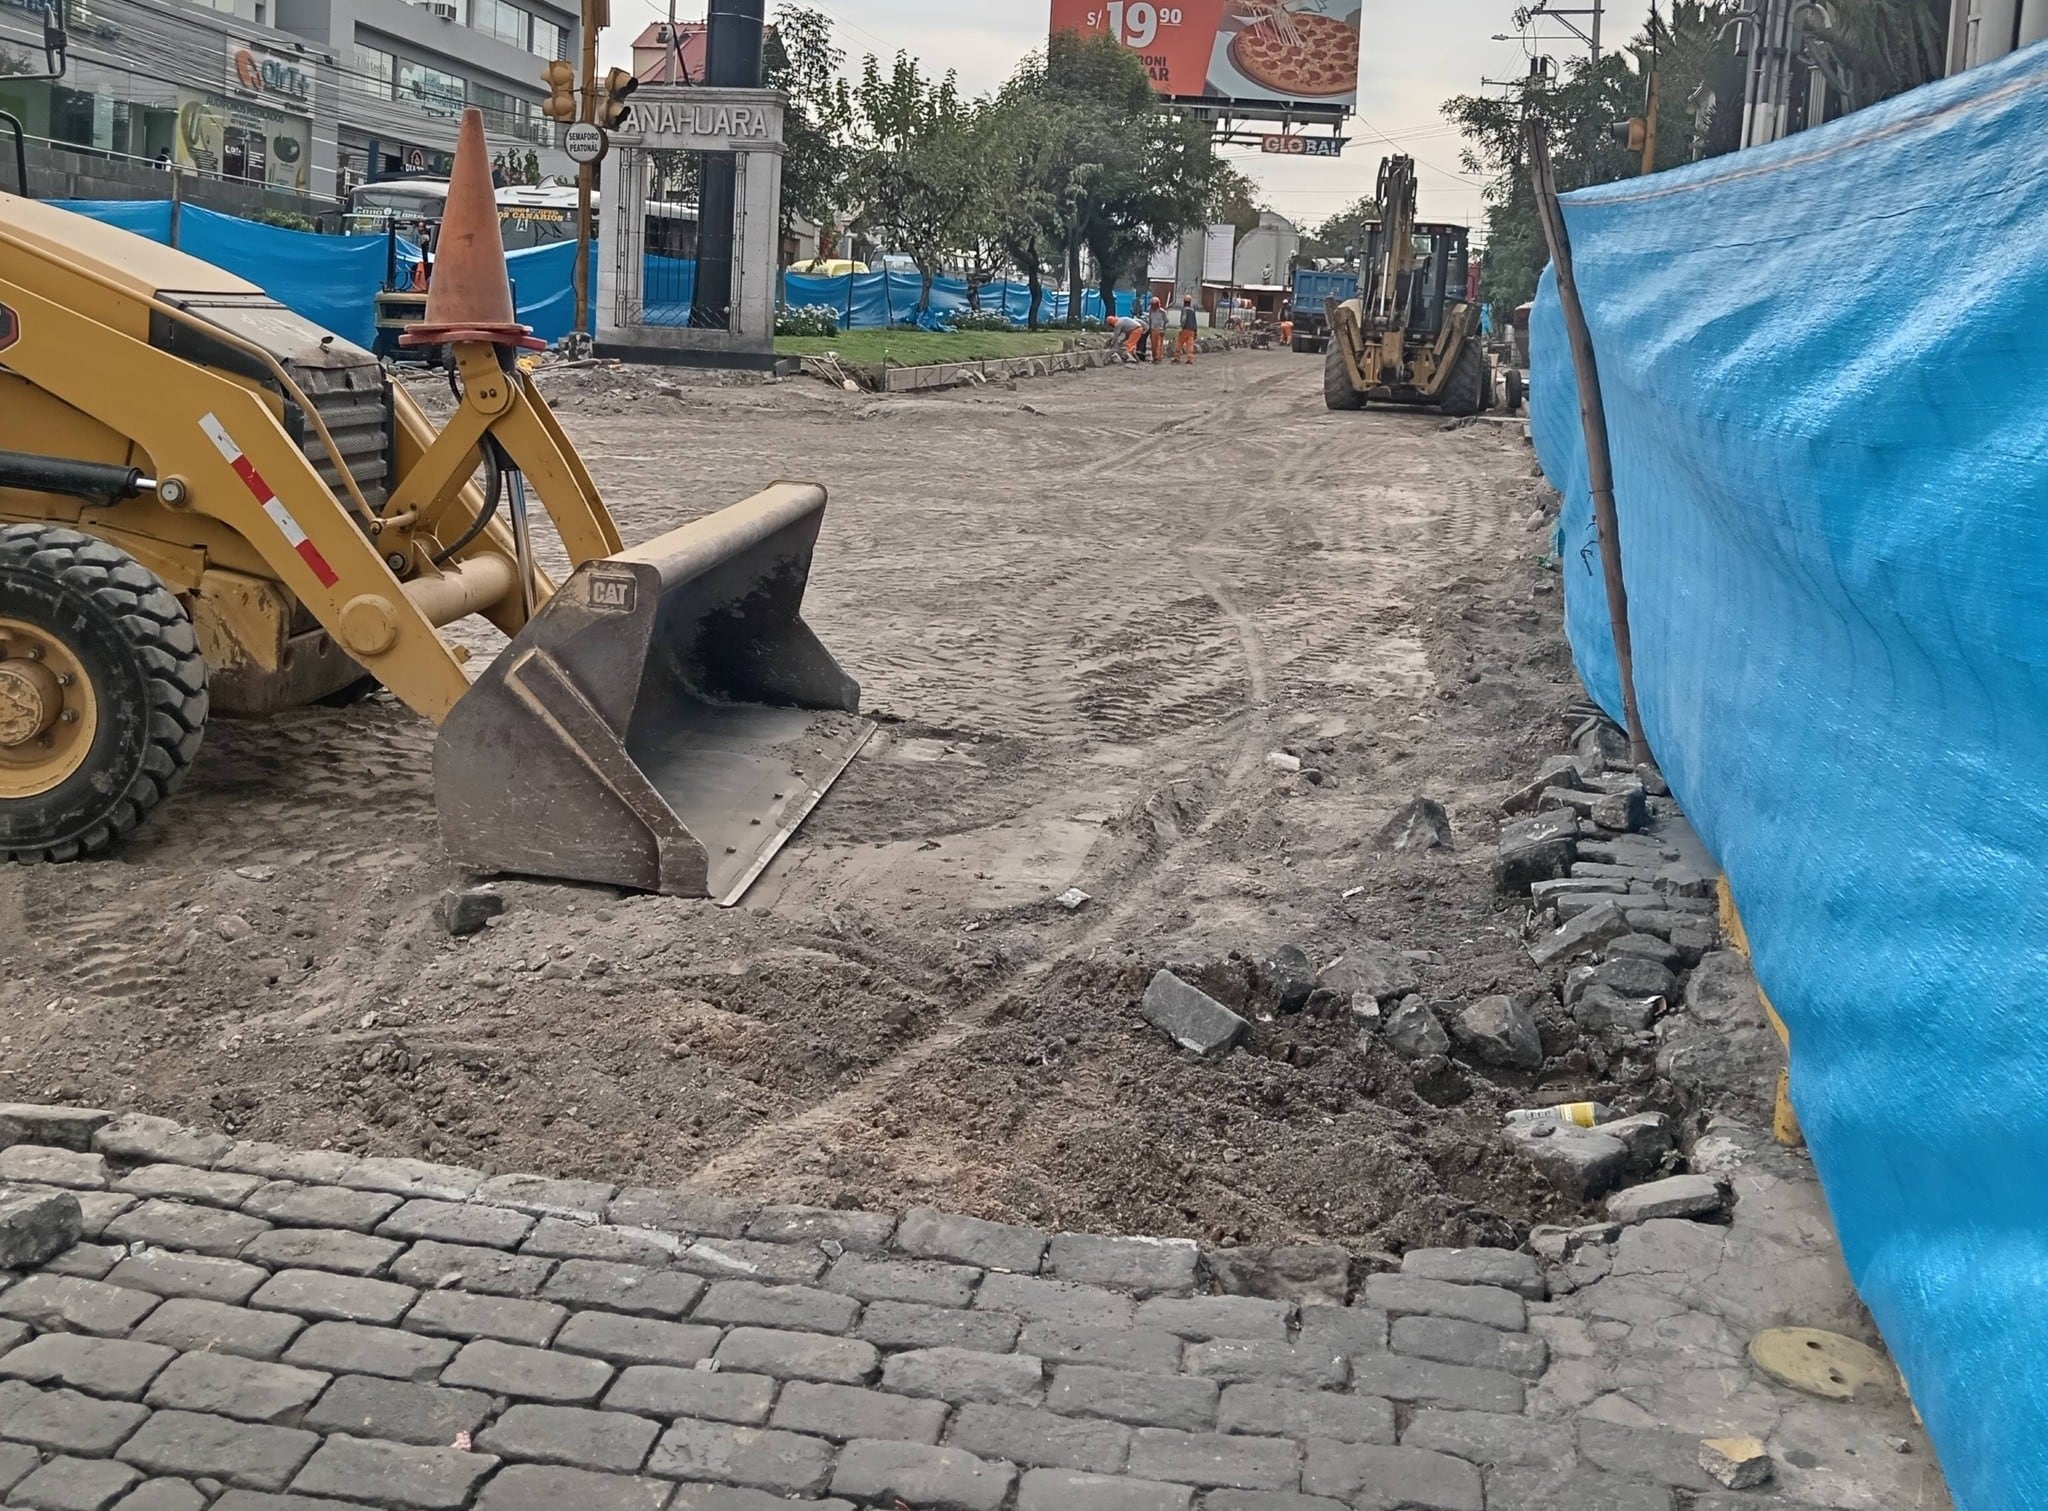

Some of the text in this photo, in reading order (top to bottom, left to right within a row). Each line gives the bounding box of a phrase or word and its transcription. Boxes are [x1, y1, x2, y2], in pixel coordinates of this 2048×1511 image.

[1087, 1, 1182, 48] S/ 19 90
[624, 104, 768, 137] ANAHUARA
[569, 132, 599, 141] SEMAFORO
[1265, 136, 1339, 155] GLOBAL
[570, 143, 598, 152] PEATONAL
[512, 212, 564, 221] CANARIOS
[593, 582, 627, 605] CAT
